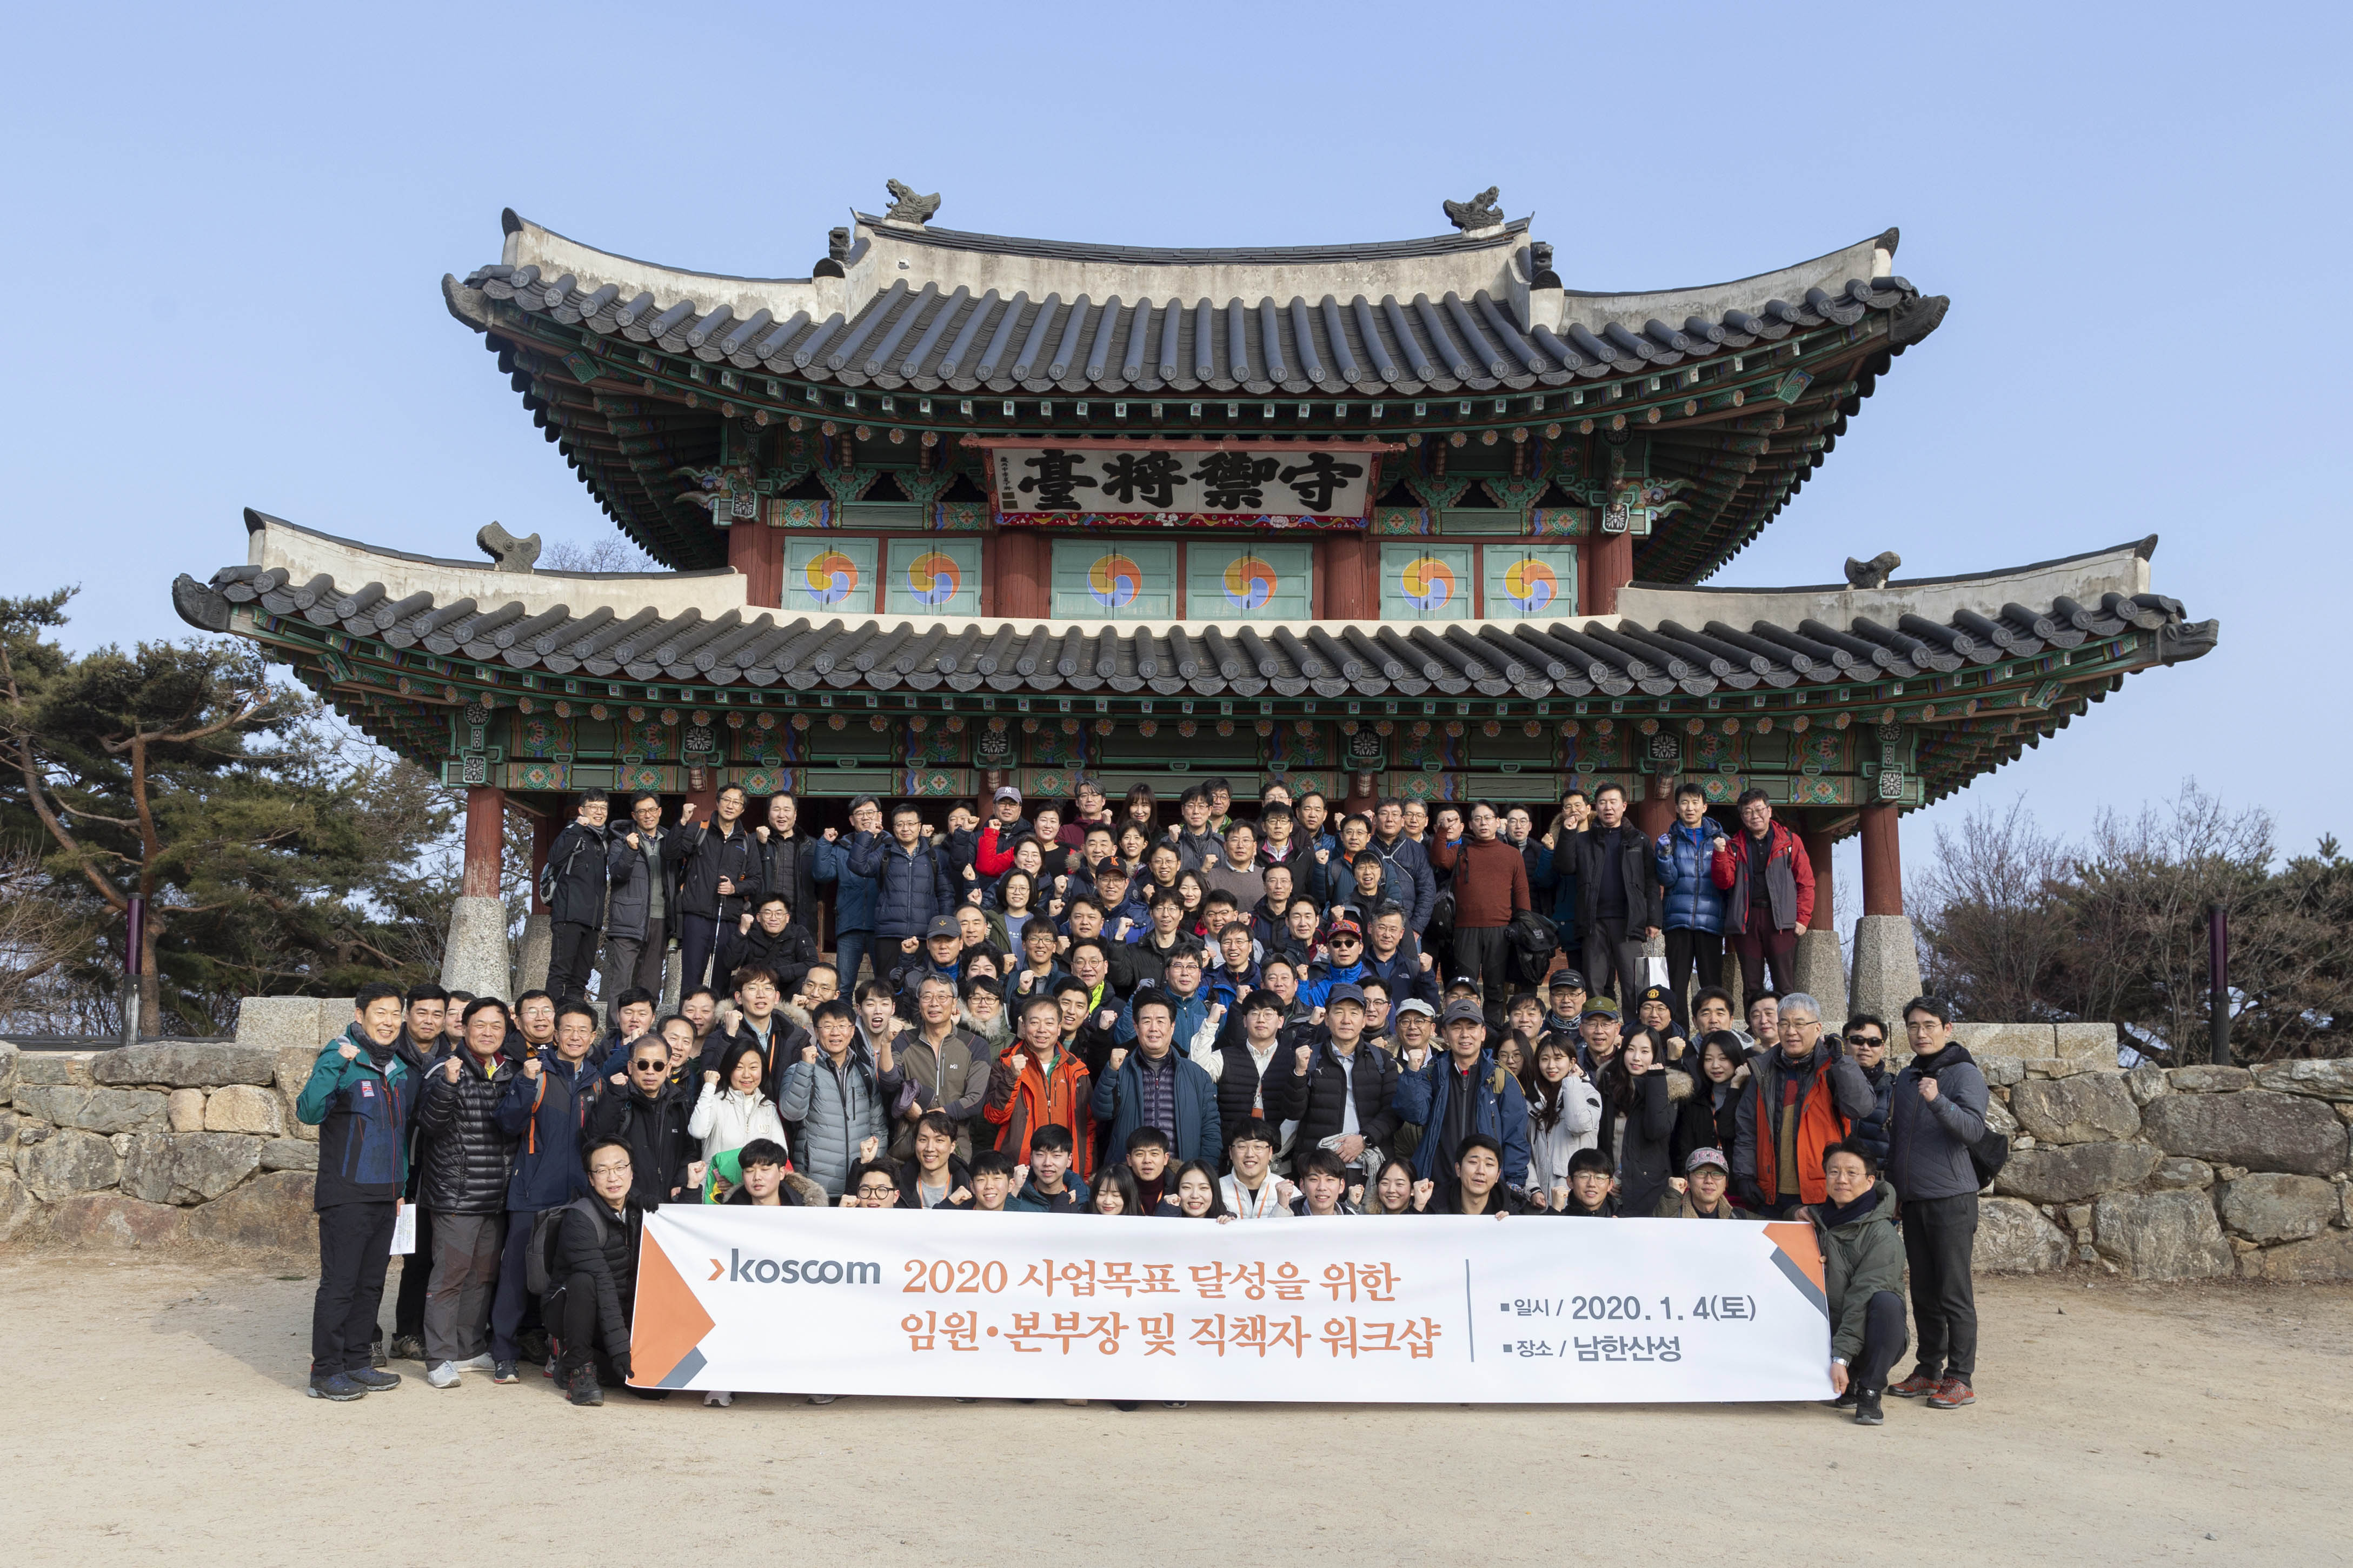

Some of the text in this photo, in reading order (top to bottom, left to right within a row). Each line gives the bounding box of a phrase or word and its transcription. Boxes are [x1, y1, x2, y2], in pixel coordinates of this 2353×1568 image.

[730, 1248, 881, 1284] koscom
[902, 1259, 1401, 1303] 2020 사업목표 달성을 위한
[1514, 1299, 1549, 1317] 일시
[1692, 1295, 1756, 1322] 4(토)
[1138, 1312, 1176, 1356] 및
[1189, 1313, 1311, 1358] 직책자
[1319, 1316, 1441, 1359] 워크샵
[1517, 1340, 1553, 1358] 장소
[1573, 1336, 1681, 1362] 남한산성
